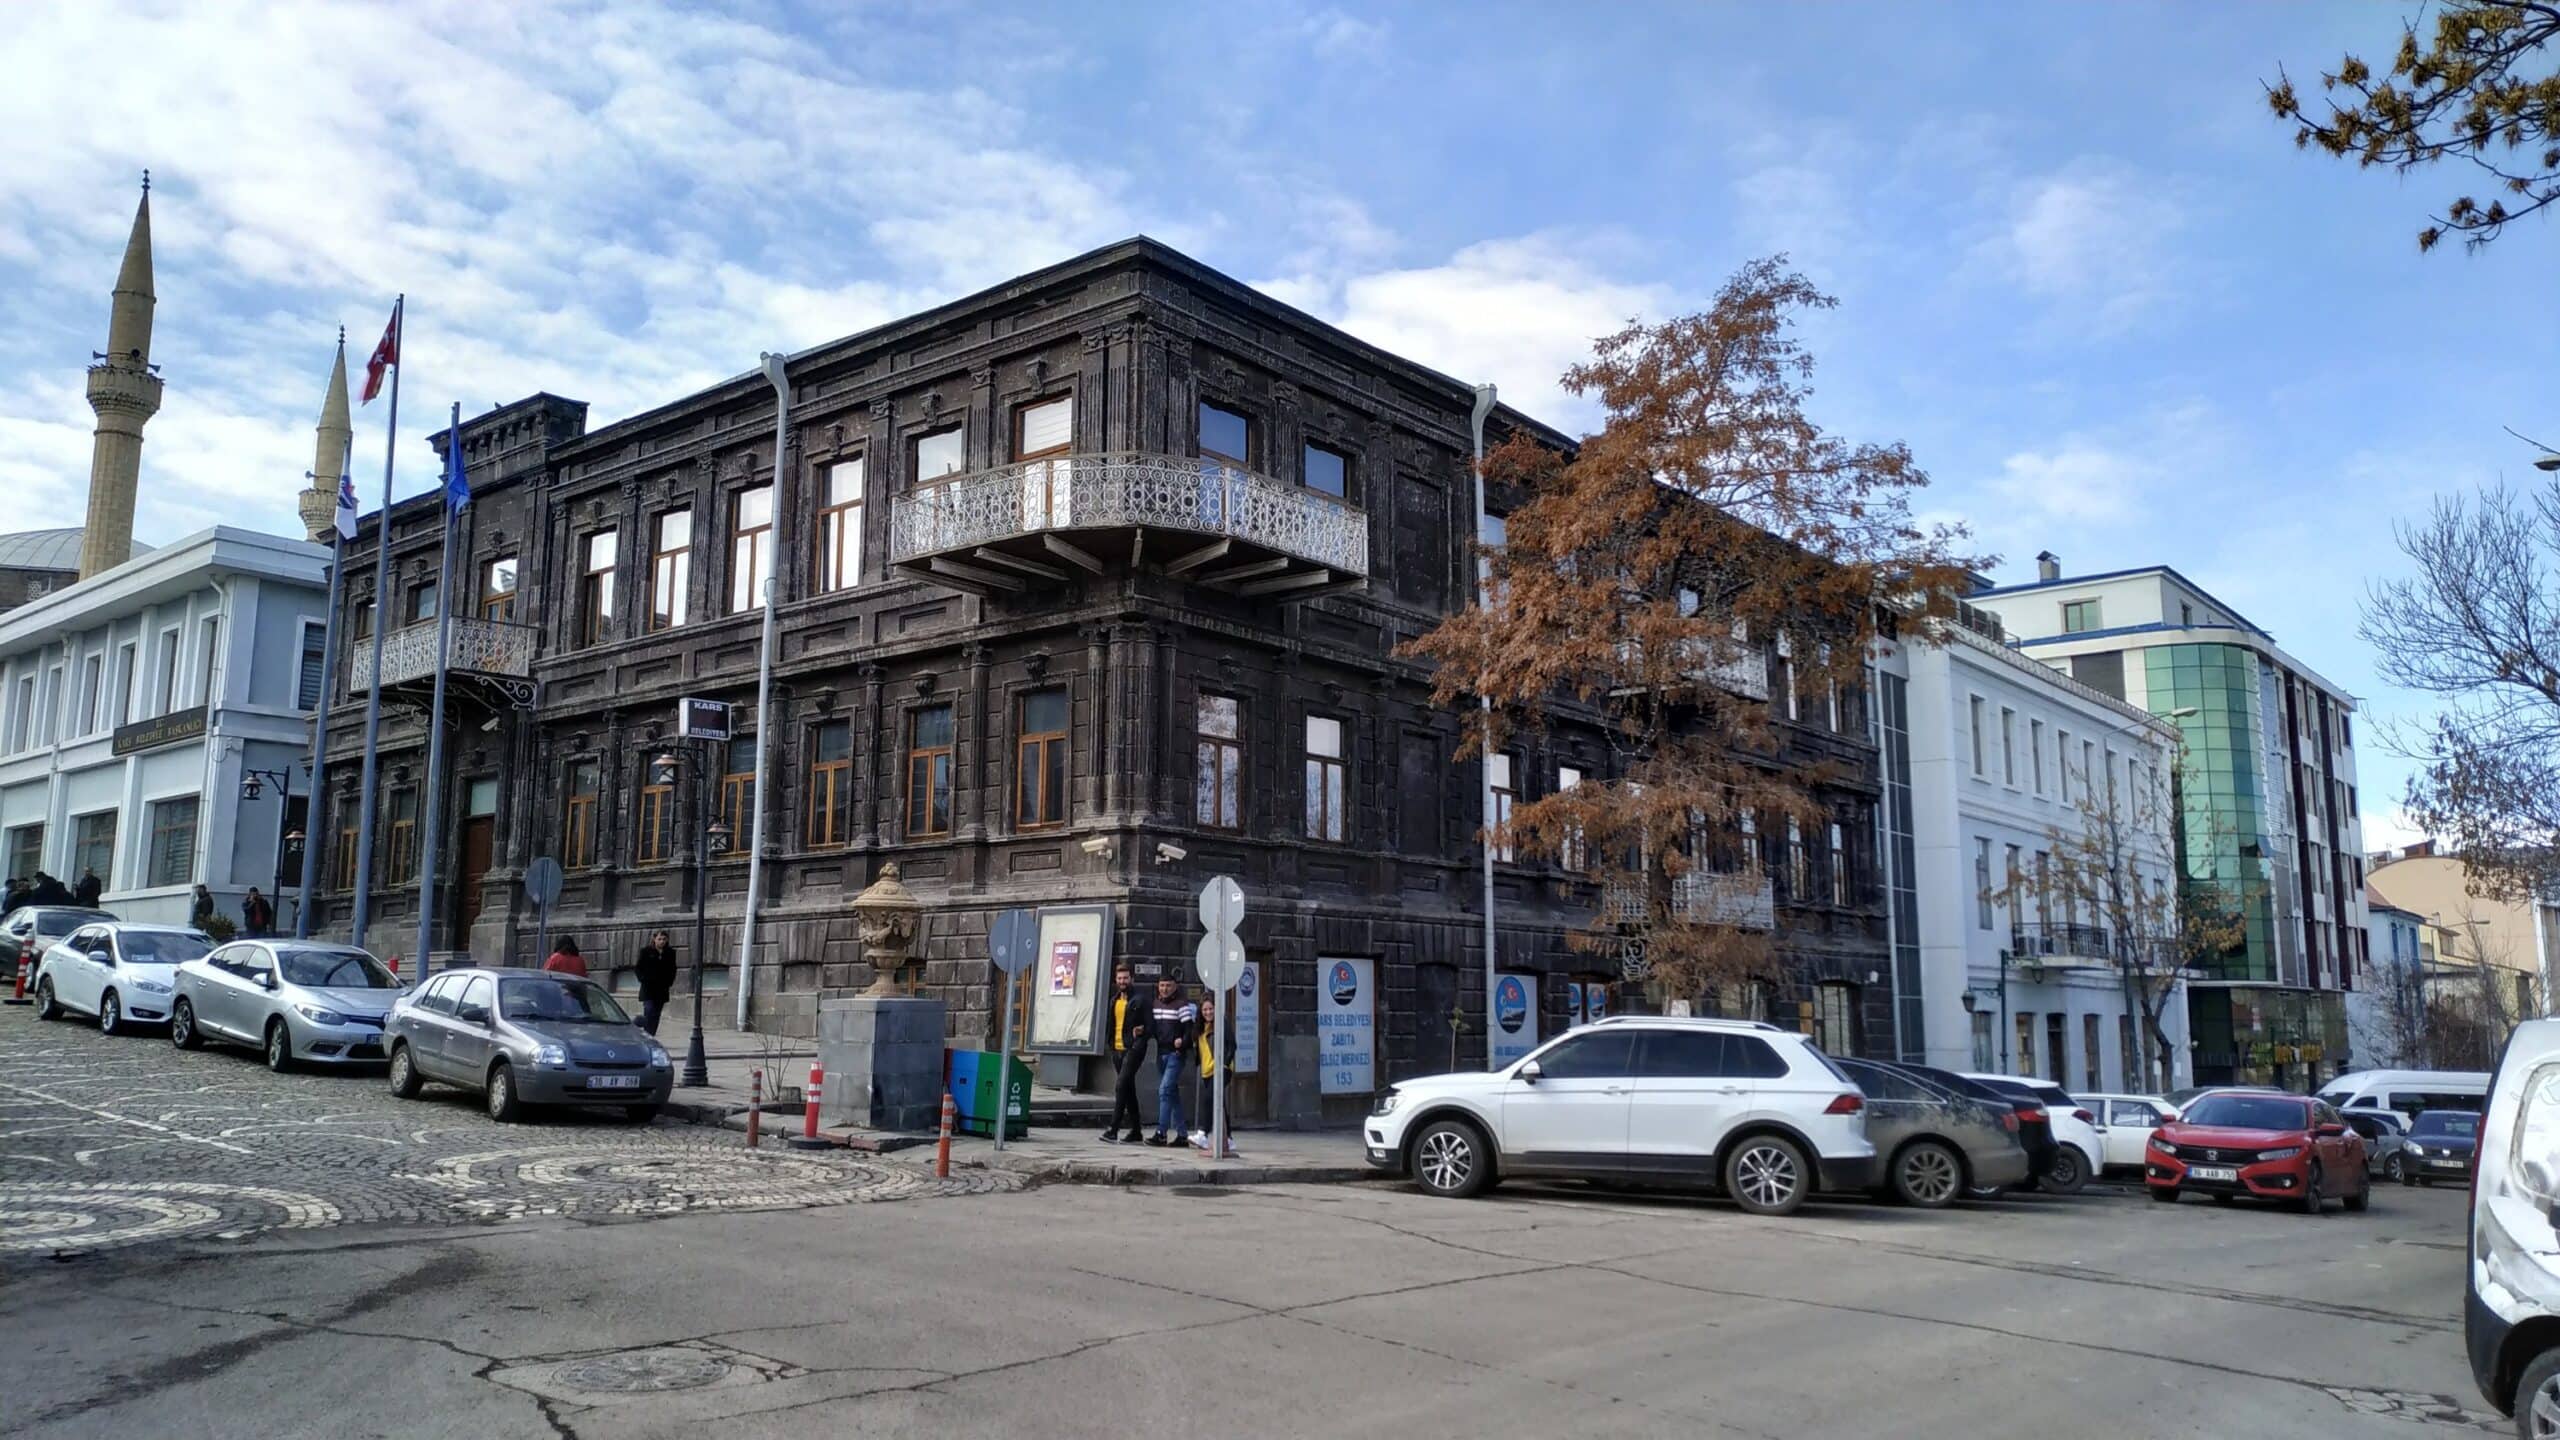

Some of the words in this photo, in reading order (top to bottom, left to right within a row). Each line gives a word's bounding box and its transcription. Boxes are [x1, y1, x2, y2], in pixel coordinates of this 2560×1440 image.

[694, 702, 722, 711] KARS
[1319, 1014, 1333, 1027] ARS
[1320, 1050, 1340, 1067] ELSİZ
[1335, 1071, 1353, 1086] 153
